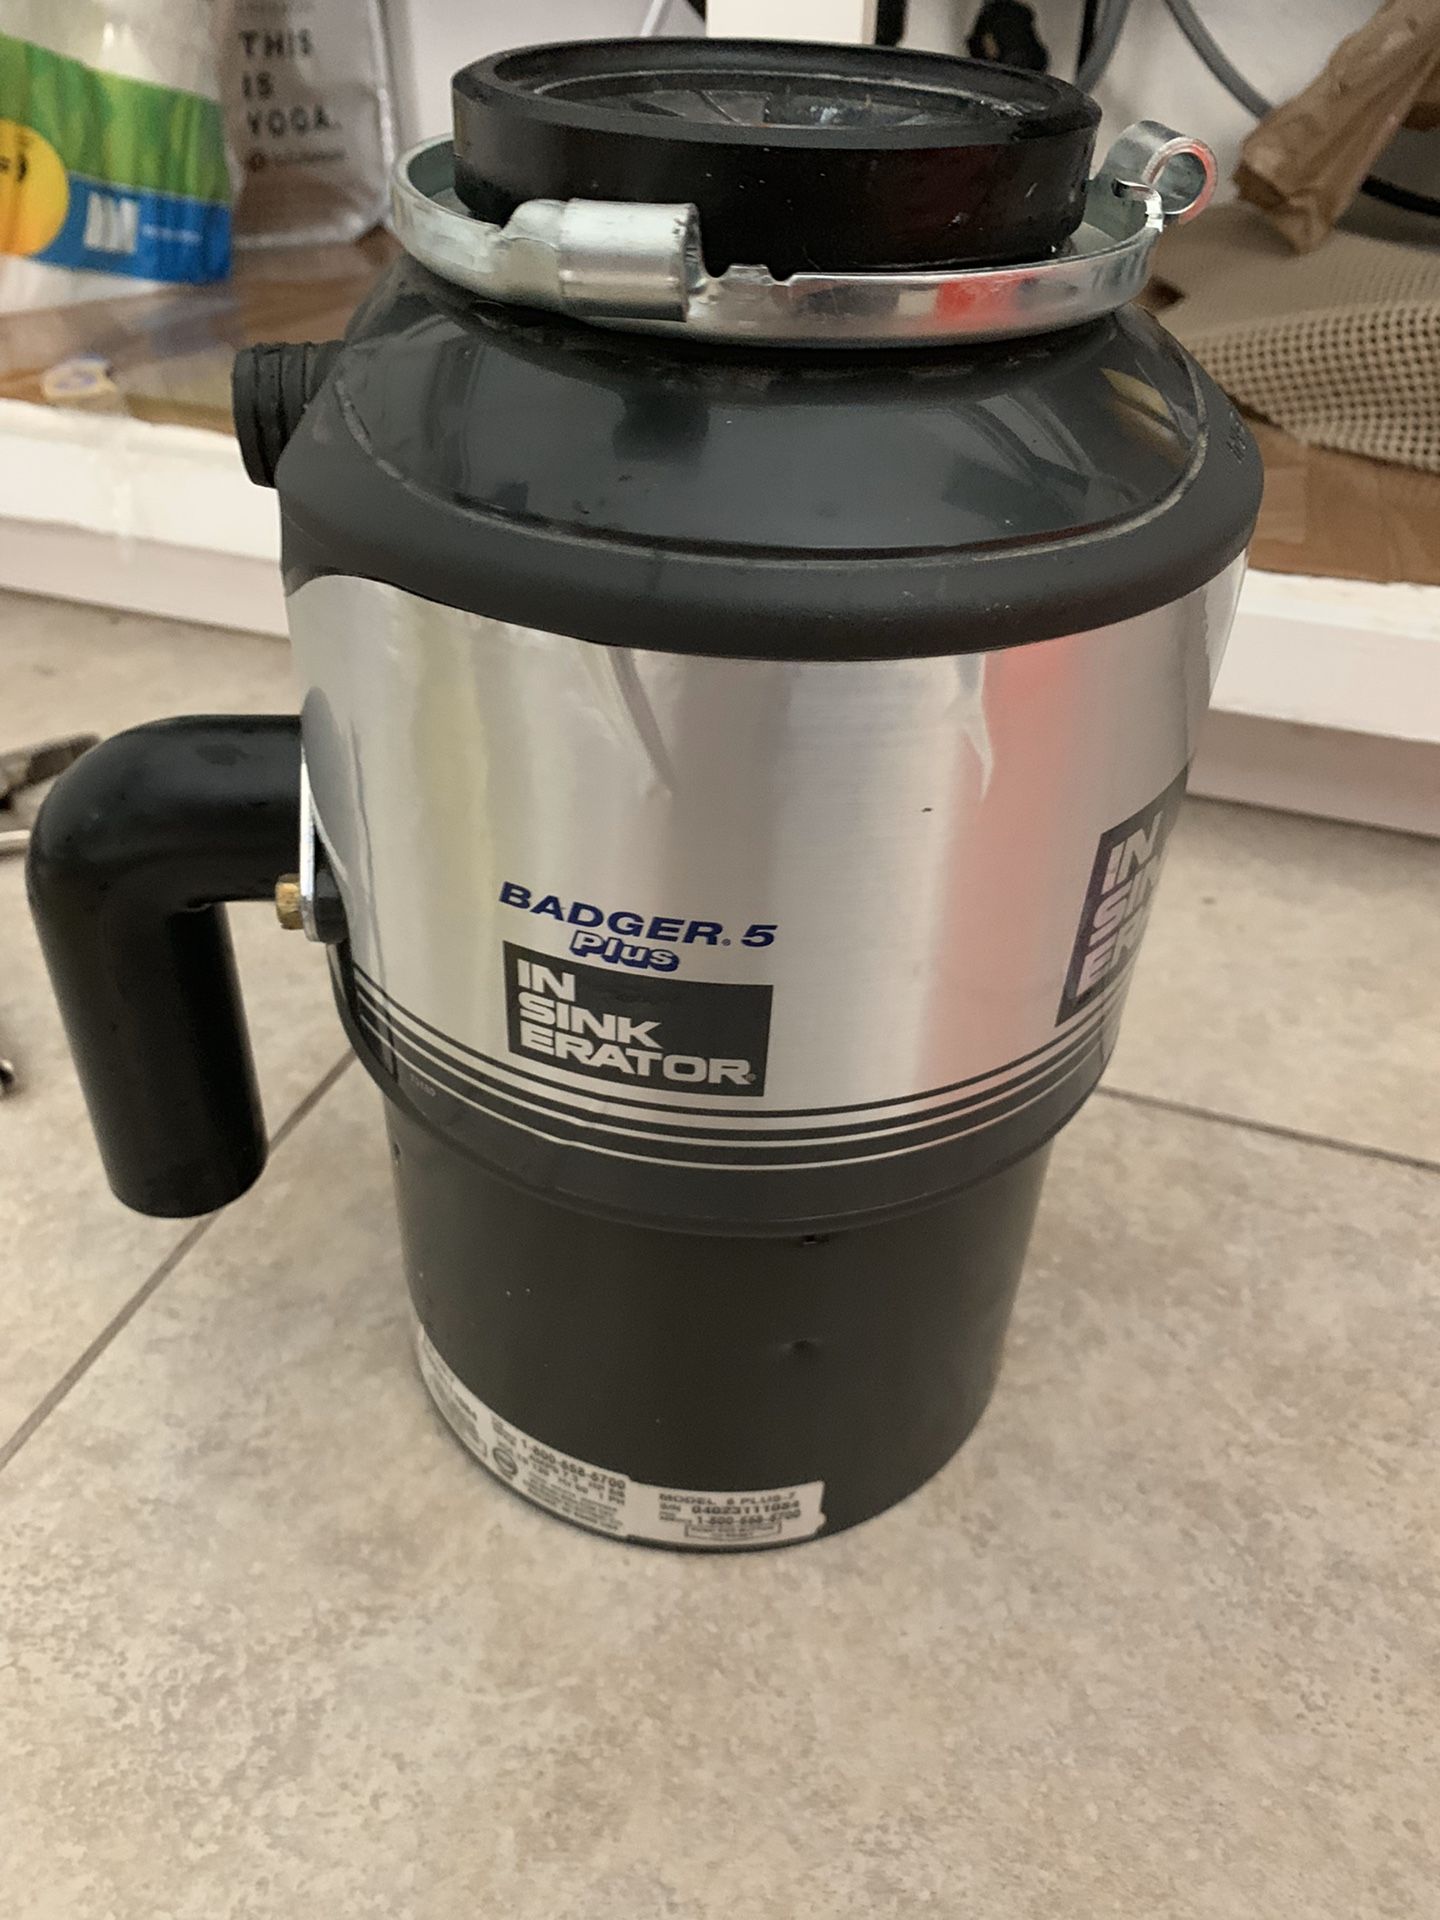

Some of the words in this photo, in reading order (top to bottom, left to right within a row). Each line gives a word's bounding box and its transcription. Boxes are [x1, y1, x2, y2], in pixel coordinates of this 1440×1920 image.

[239, 28, 313, 58] THIS
[242, 71, 274, 99] IS
[569, 930, 680, 972] Plus
[741, 923, 779, 947] 5
[516, 958, 576, 1002] IN
[518, 991, 664, 1050] SINK
[520, 1020, 753, 1086] ERATOR
